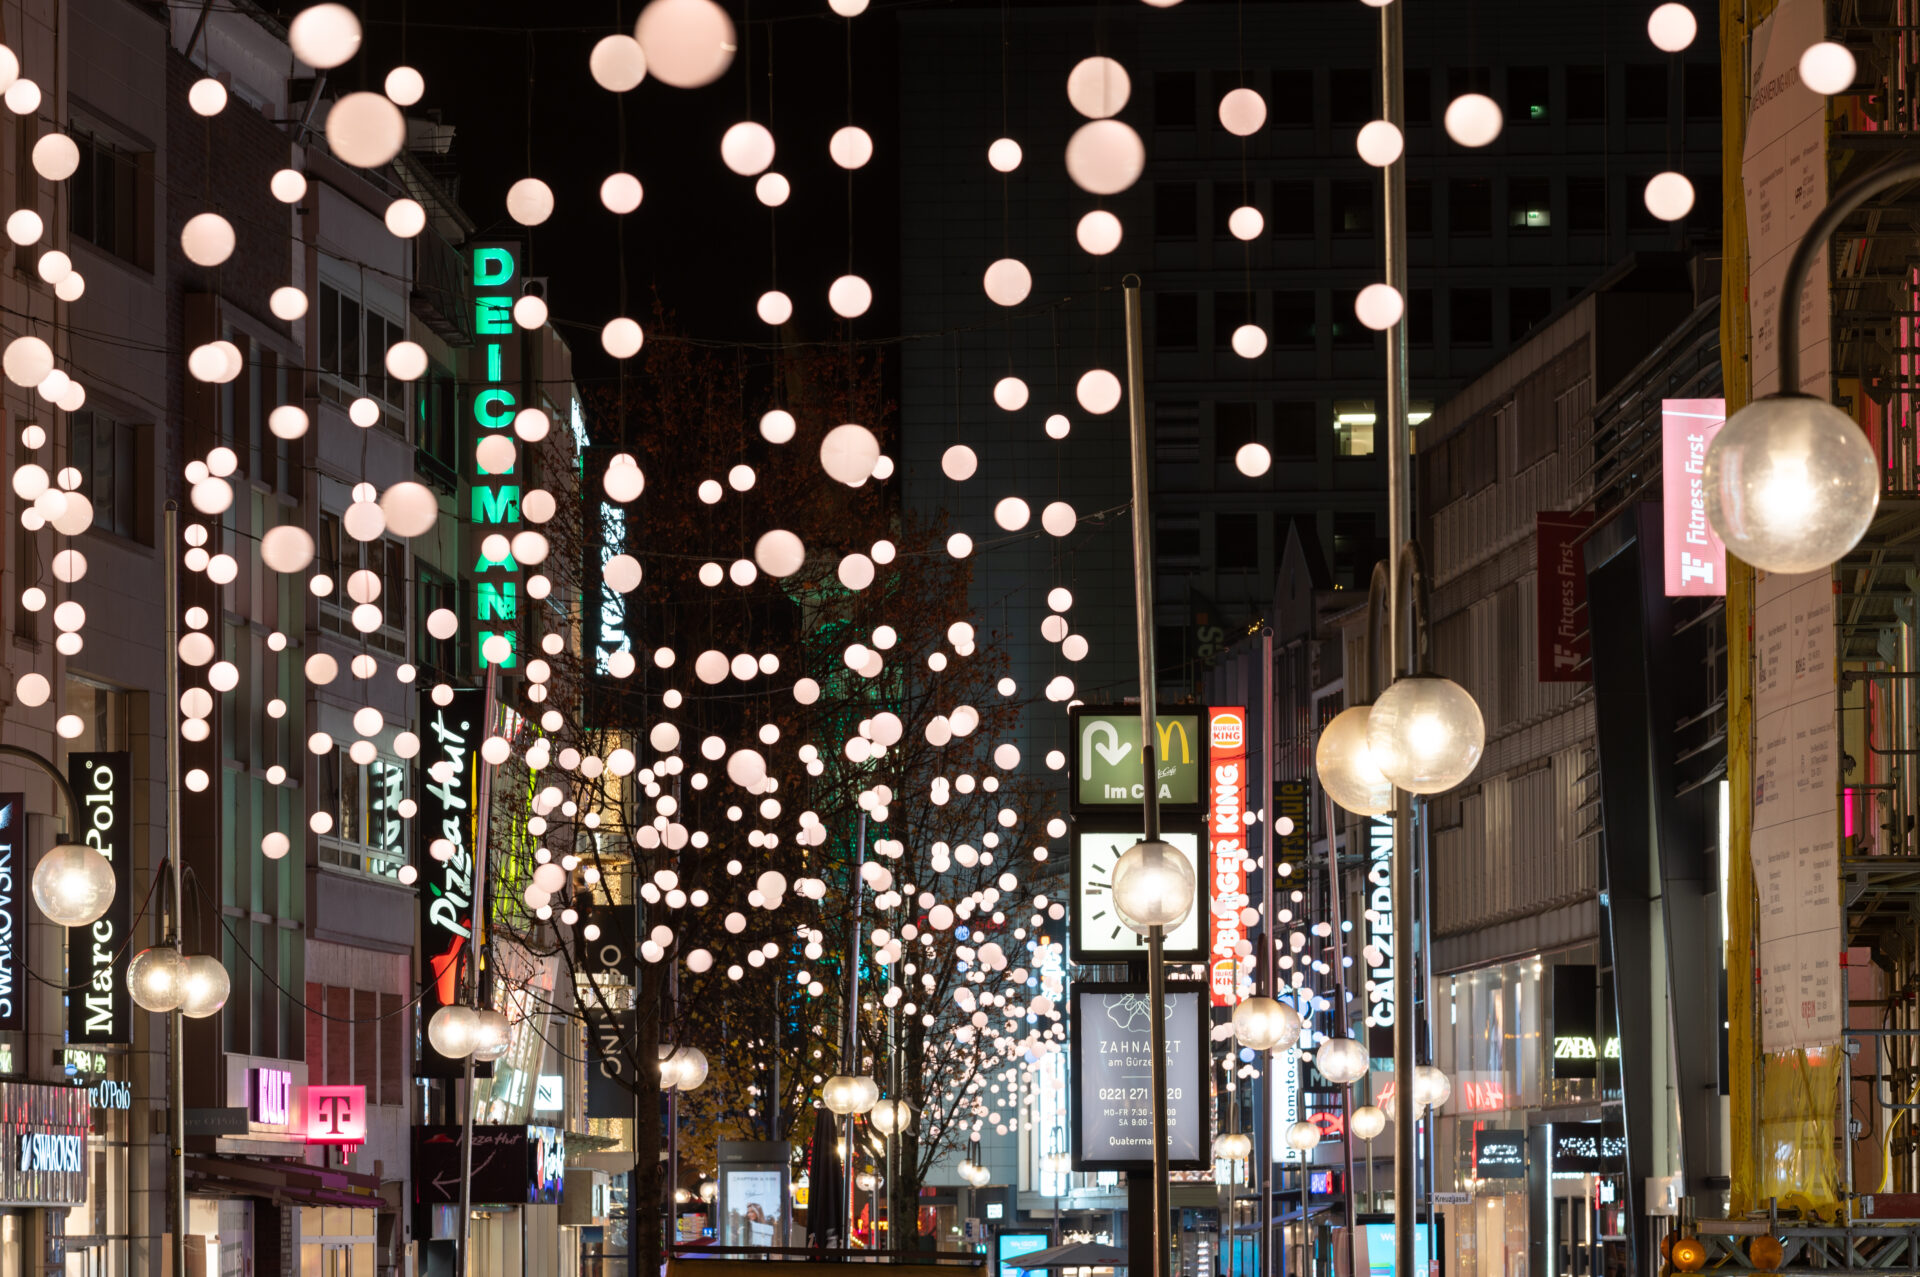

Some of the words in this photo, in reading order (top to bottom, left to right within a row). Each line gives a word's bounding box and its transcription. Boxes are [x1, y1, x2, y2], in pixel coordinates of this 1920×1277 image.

[1685, 433, 1704, 473] First
[1686, 478, 1708, 545] Fitness
[1557, 541, 1573, 577] First
[1558, 580, 1575, 638] Fitness
[1104, 784, 1127, 799] Im
[1131, 783, 1172, 799] CA
[1216, 764, 1239, 833] KING
[1216, 839, 1239, 946] BURGER
[86, 920, 113, 1036] Marc
[1100, 1041, 1181, 1053] ZAHNAZT
[1126, 1057, 1173, 1066] Gürzeh
[1099, 1088, 1126, 1100] 0221
[1129, 1088, 1148, 1100] 271
[33, 1134, 81, 1172] SWAROVSKI
[495, 1133, 522, 1145] Hut
